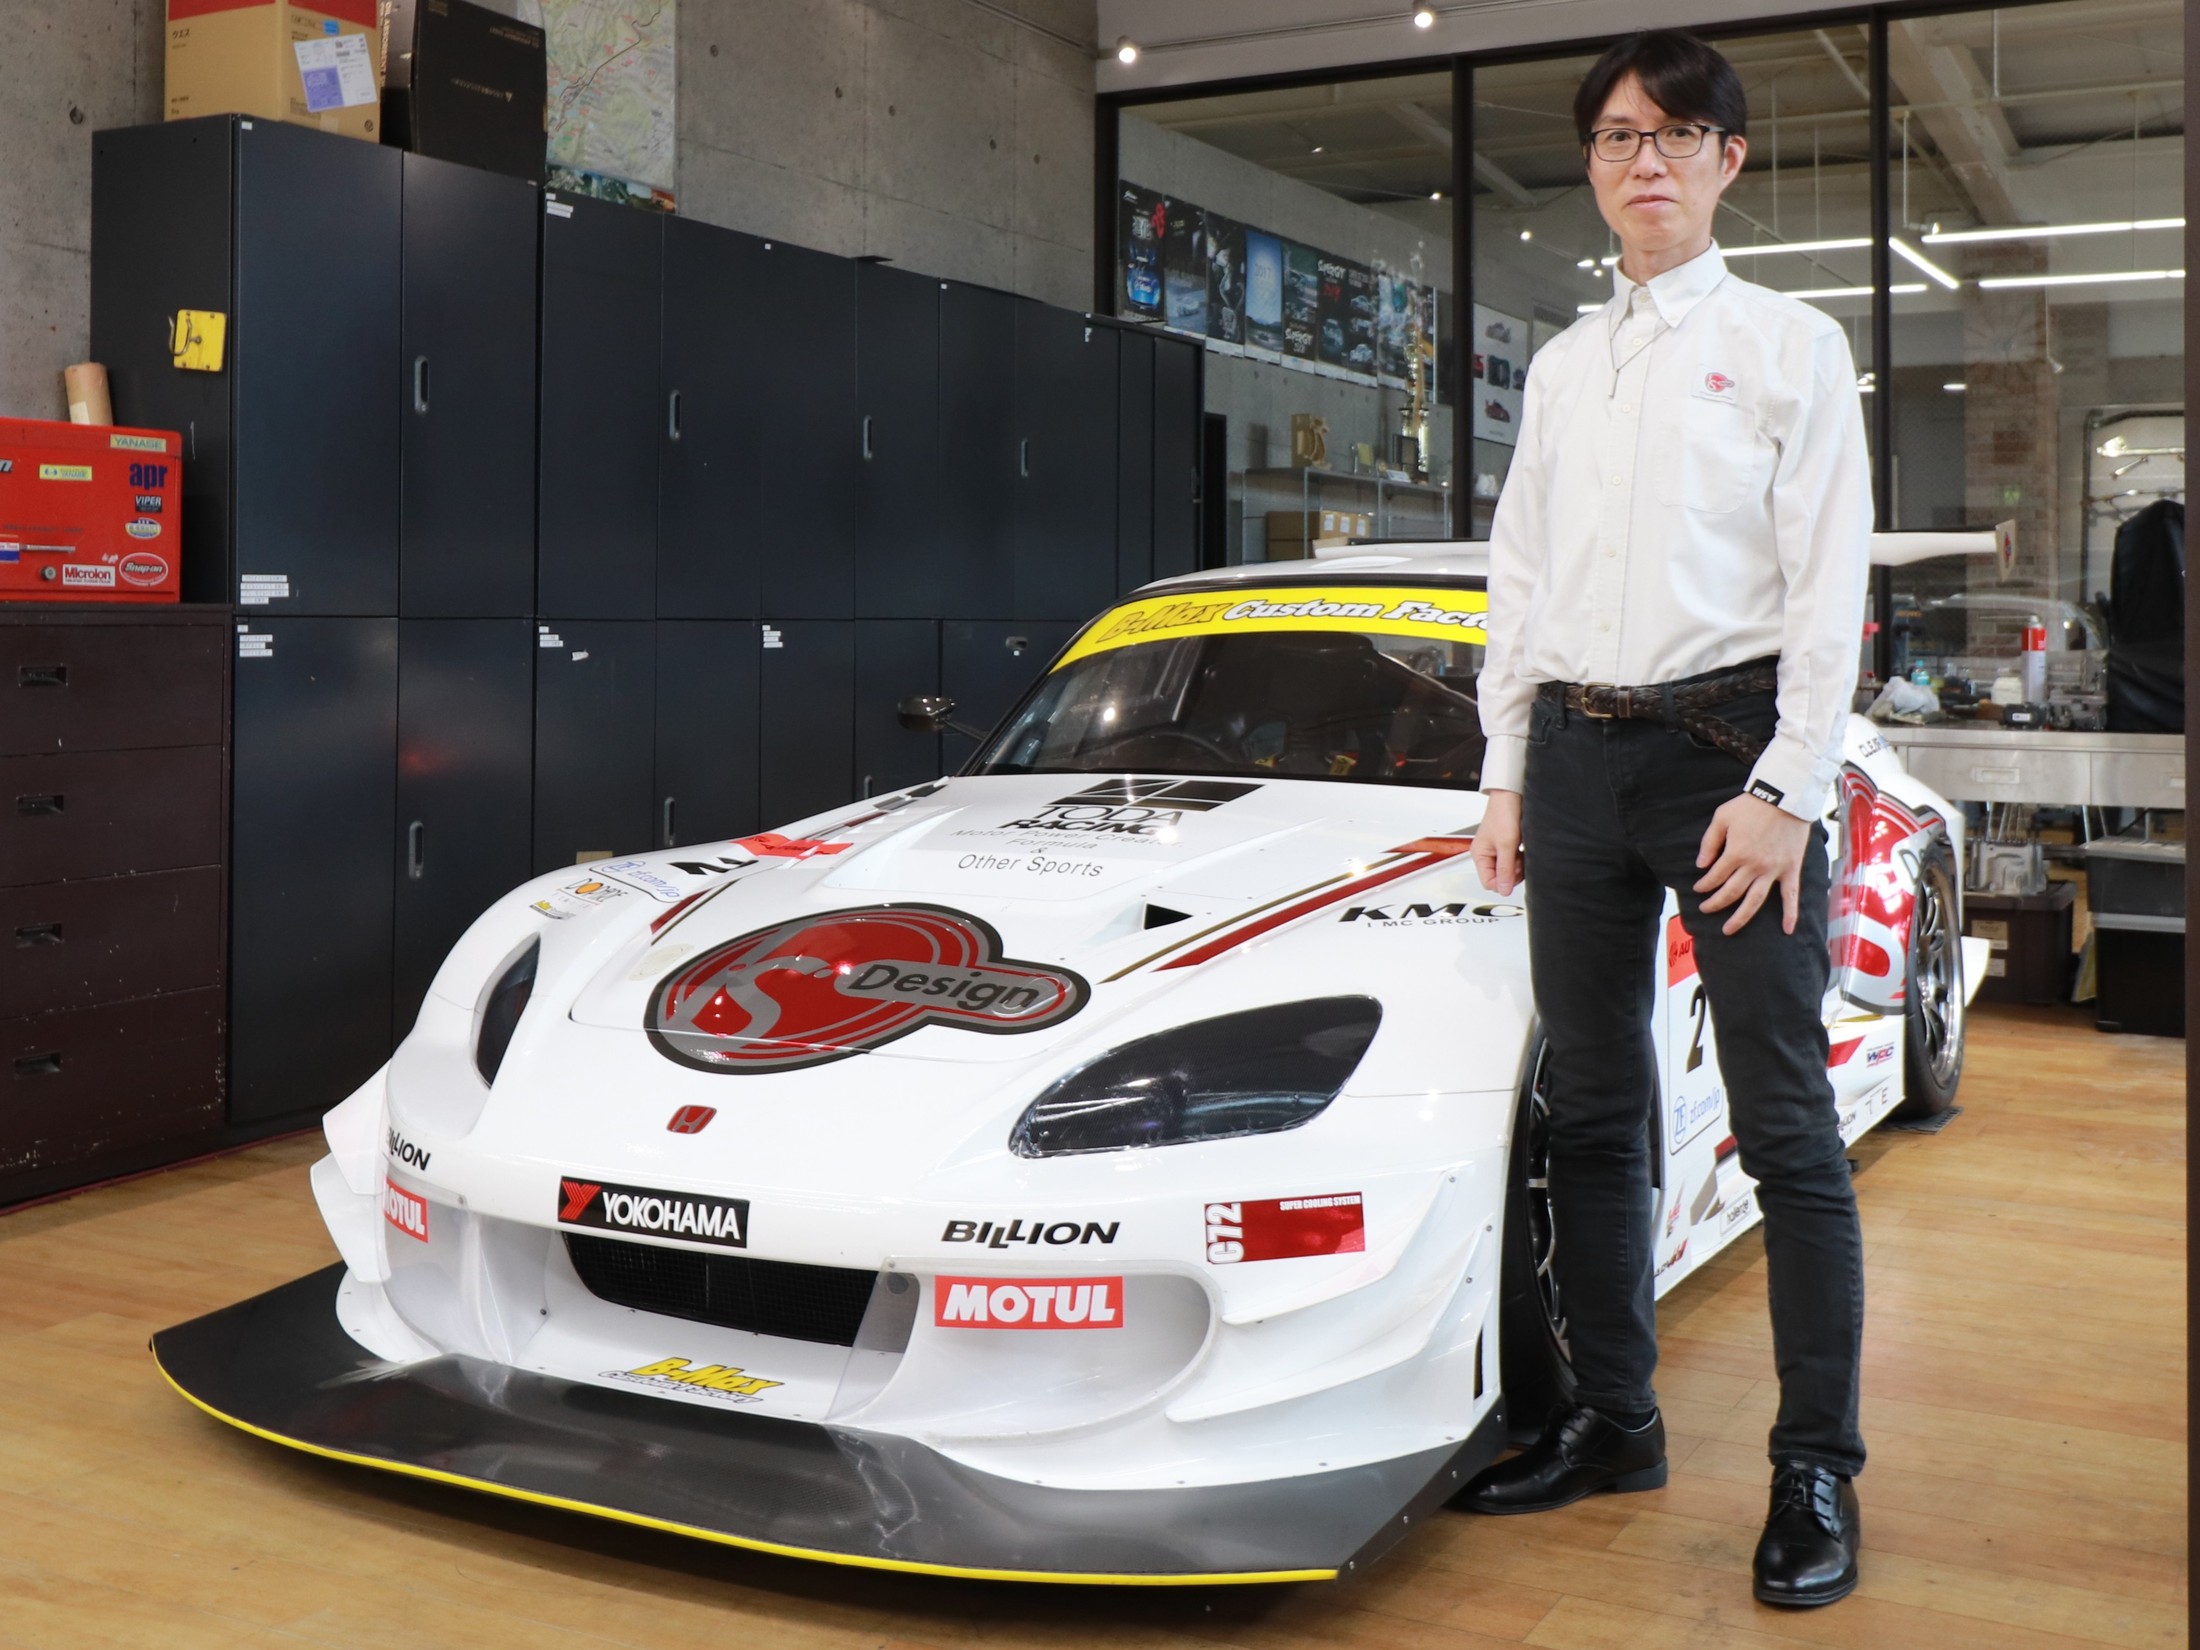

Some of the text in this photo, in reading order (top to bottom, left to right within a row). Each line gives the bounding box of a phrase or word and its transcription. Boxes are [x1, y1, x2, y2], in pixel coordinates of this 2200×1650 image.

[129, 463, 168, 490] apr
[135, 495, 162, 506] VIPER
[124, 561, 163, 575] Snap-on
[1097, 602, 1232, 643] B-Max
[1223, 598, 1384, 621] Custom
[1034, 806, 1183, 826] TODA
[997, 819, 1168, 836] RACING
[1020, 830, 1085, 839] Power
[1005, 838, 1100, 850] Formula
[957, 854, 1104, 878] Other Sports
[1338, 903, 1525, 922] KMC
[1423, 917, 1500, 926] GROUP
[847, 963, 1042, 1010] Design
[1279, 1195, 1361, 1211] SUPER COOLING SYSTEM
[602, 1191, 740, 1240] YOKOHAMA
[941, 1219, 1121, 1249] BILLION
[942, 1284, 1116, 1323] MOTUL
[629, 1357, 784, 1395] B-Max
